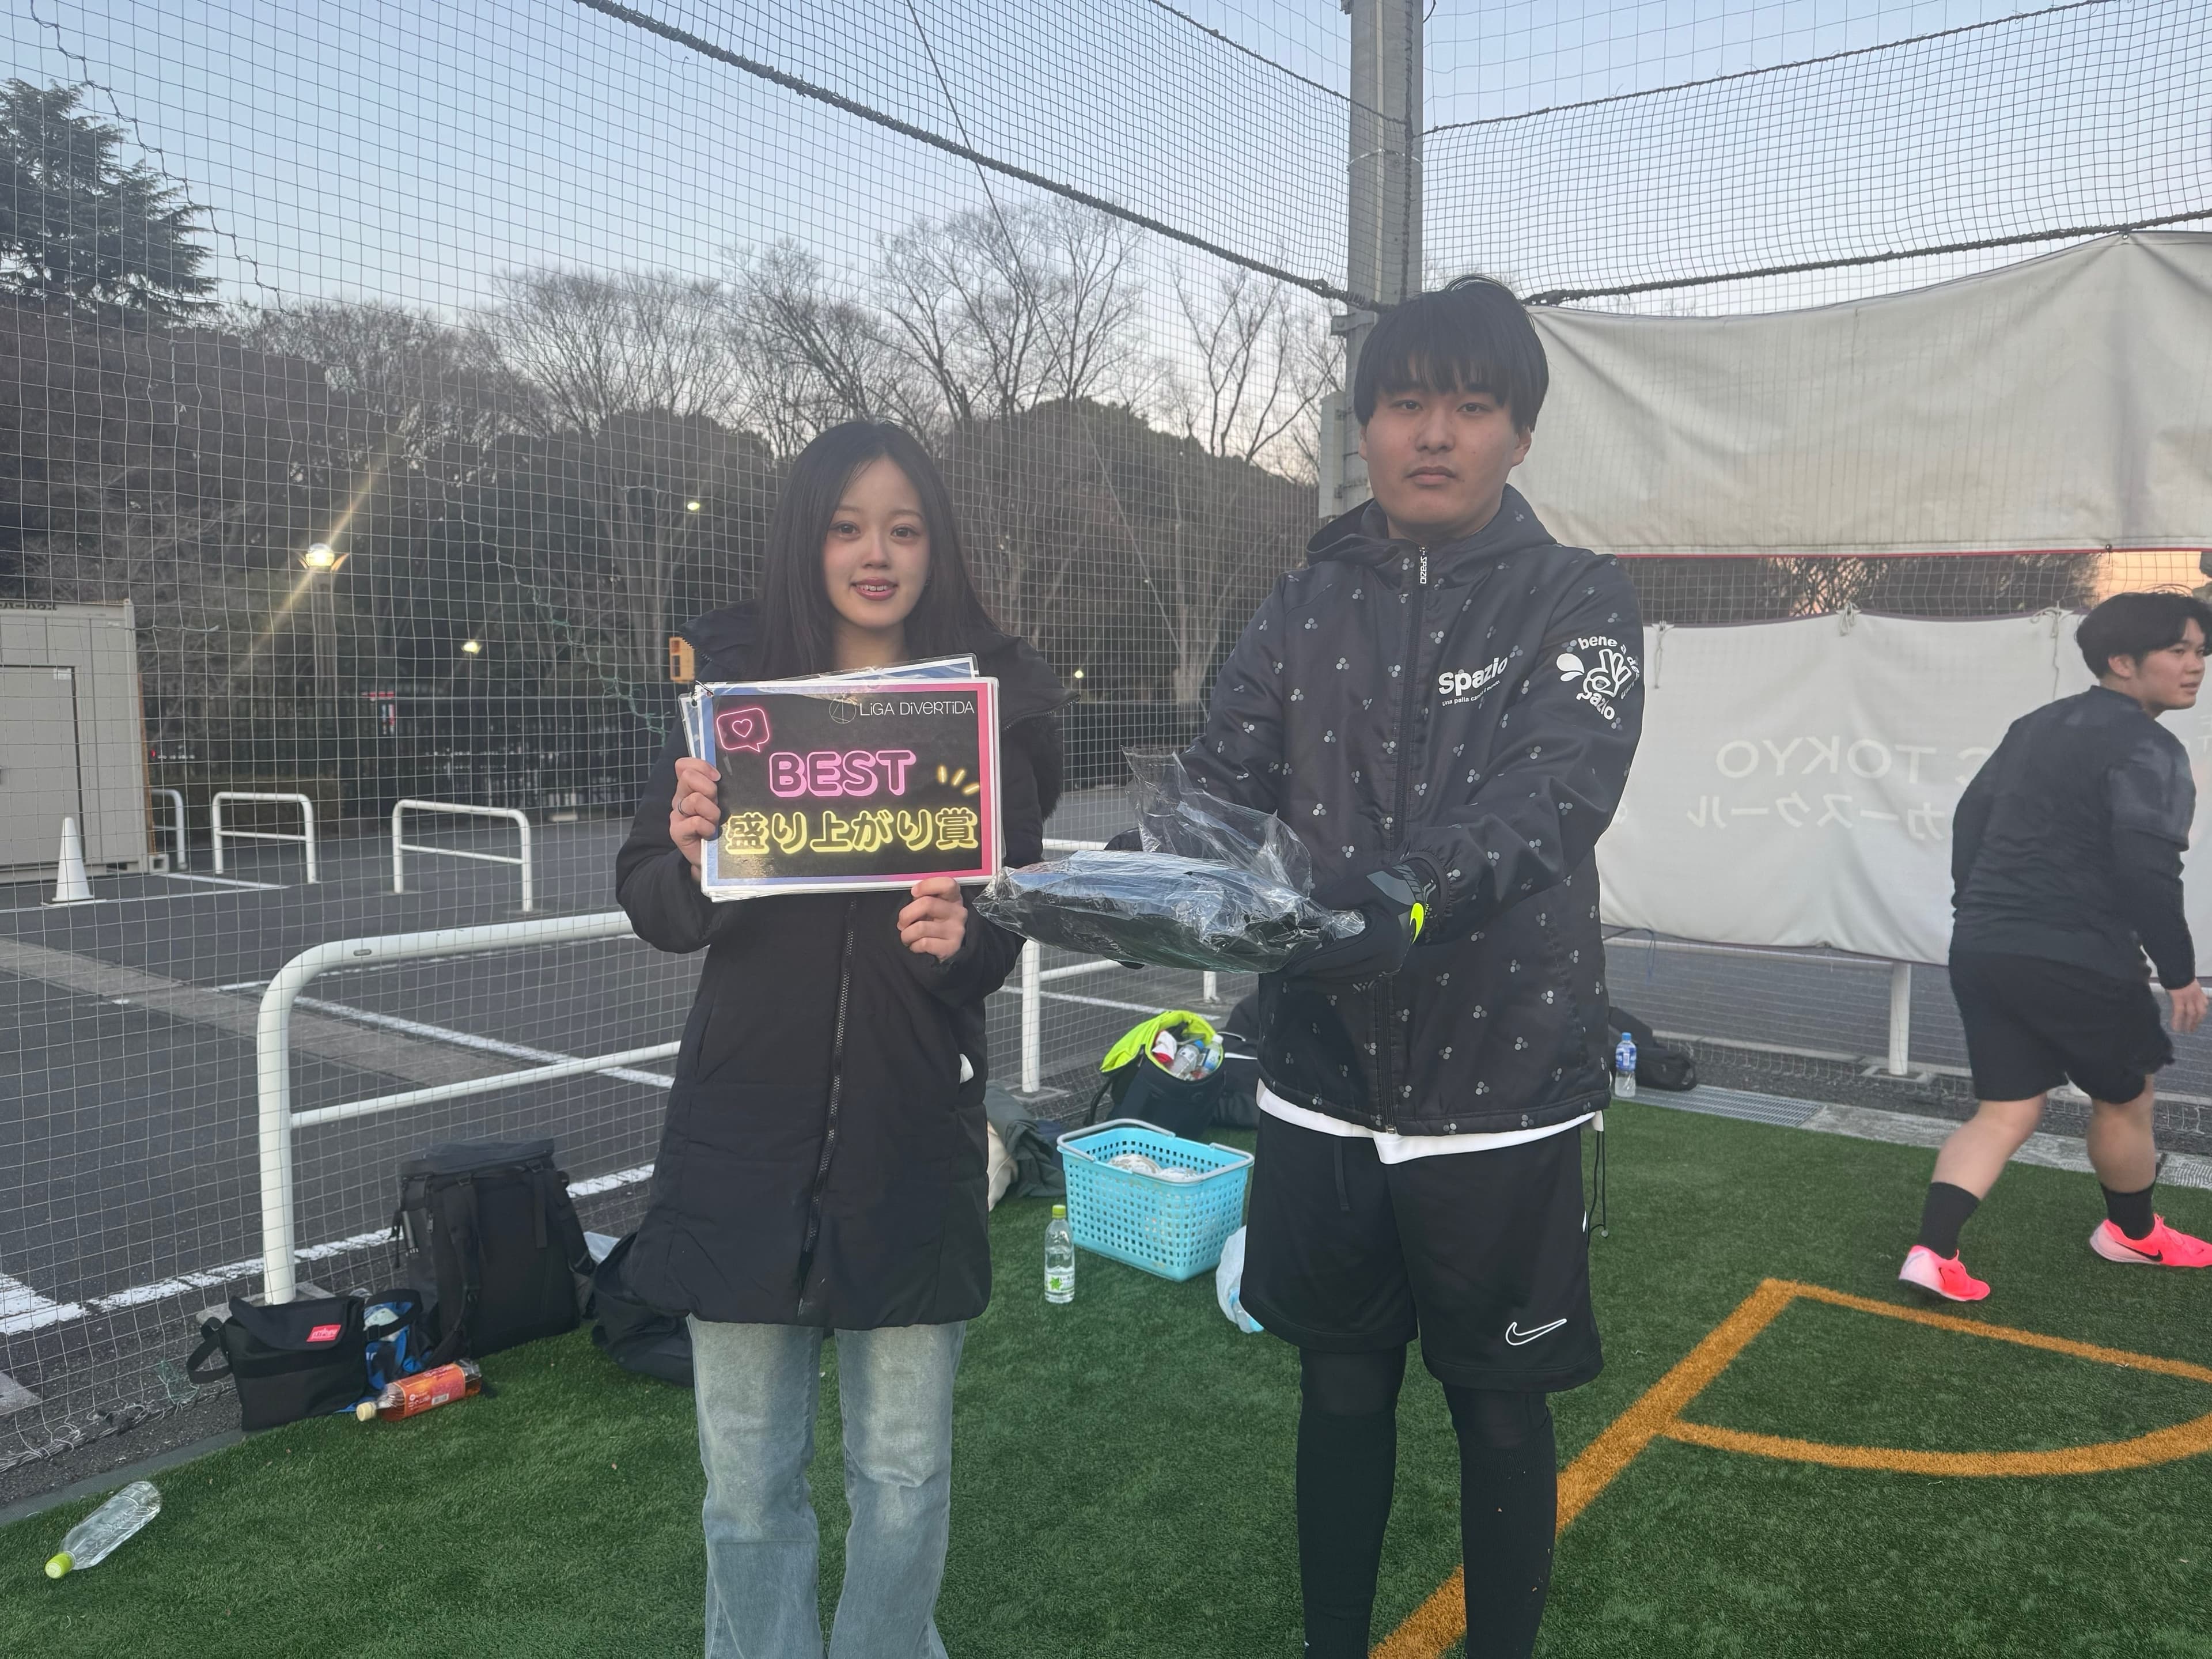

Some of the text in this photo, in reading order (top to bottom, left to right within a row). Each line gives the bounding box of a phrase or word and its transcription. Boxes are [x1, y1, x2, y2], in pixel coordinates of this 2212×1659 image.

[1578, 636, 1618, 650] bene
[1454, 696, 1469, 704] palla
[769, 749, 917, 797] BEST
[725, 808, 979, 855] 盛り上がり賞
